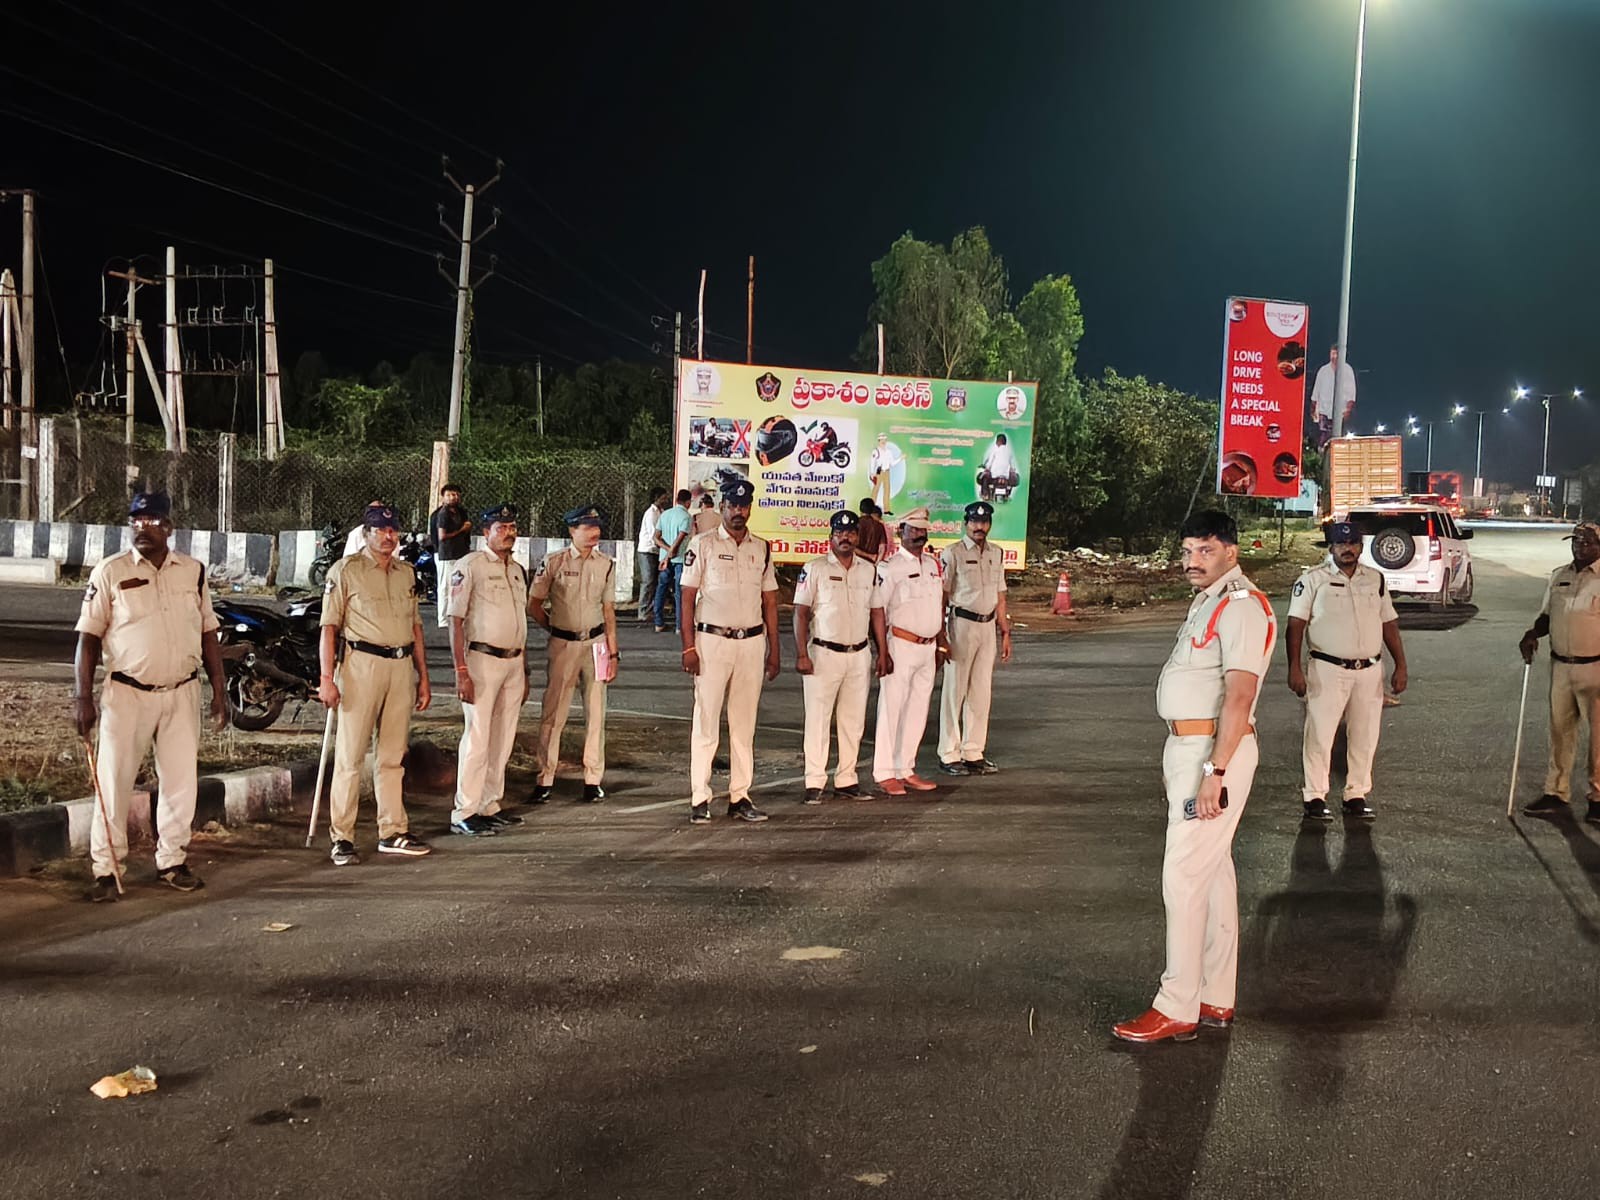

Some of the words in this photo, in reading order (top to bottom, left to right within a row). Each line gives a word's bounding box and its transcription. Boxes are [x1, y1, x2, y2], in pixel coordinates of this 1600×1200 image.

[1234, 350, 1263, 363] LONG
[1233, 366, 1261, 379] DRIVE
[791, 377, 869, 409] ప్రకాశం
[875, 382, 932, 408] పోలీస్
[1232, 382, 1263, 395] NEEDS
[1231, 398, 1239, 409] A
[1241, 399, 1280, 412] SPECIAL
[1230, 414, 1263, 427] BREAK
[762, 471, 802, 482] యువత
